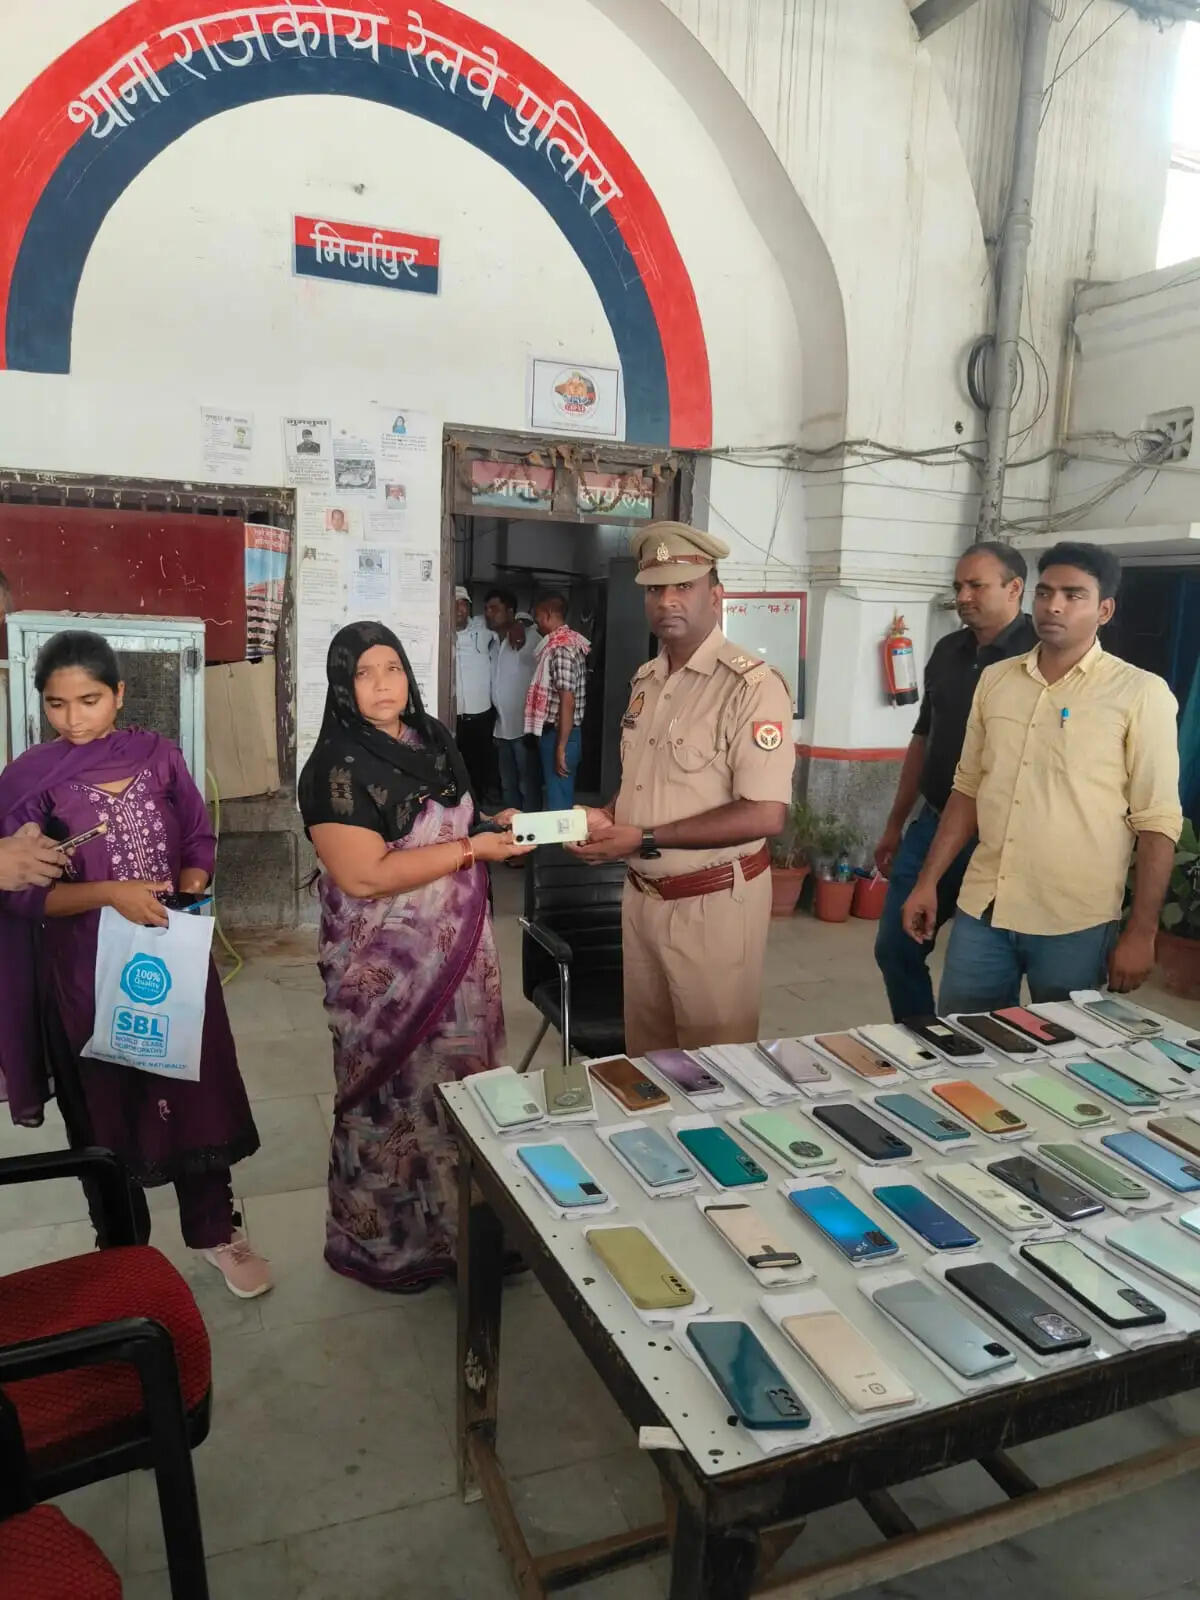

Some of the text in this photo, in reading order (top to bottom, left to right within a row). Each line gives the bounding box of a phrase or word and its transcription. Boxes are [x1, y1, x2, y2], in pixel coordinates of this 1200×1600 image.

[67, 41, 170, 139] थाना
[406, 9, 508, 111] रेलवे
[503, 83, 624, 217] पुलिस
[309, 222, 419, 280] मिर्जापुर
[134, 976, 160, 990] Quality
[135, 968, 161, 982] 100%
[116, 1011, 163, 1037] SBL
